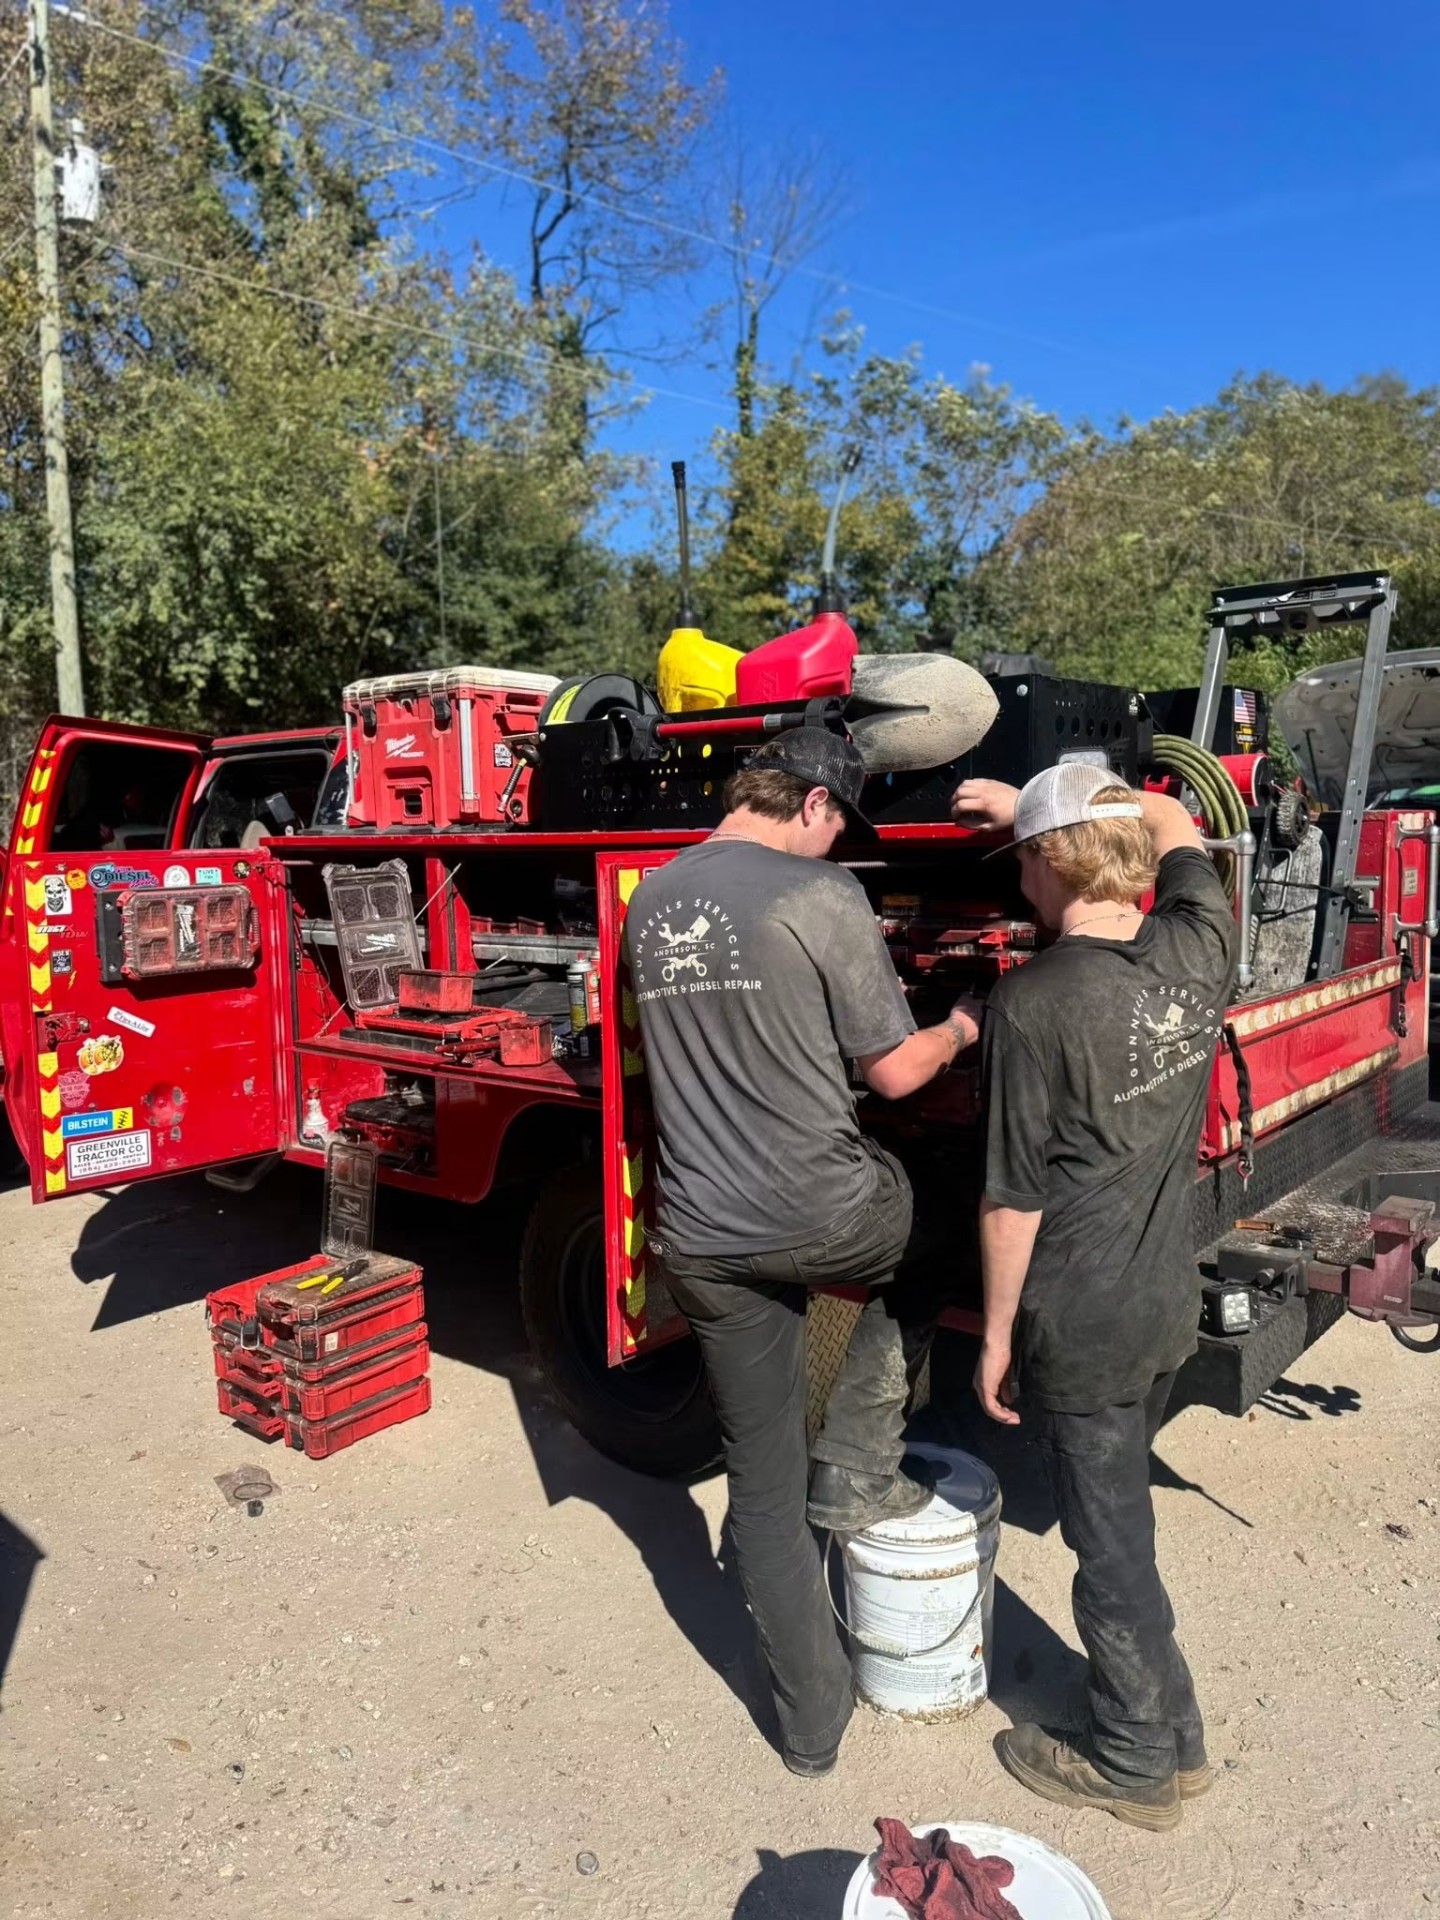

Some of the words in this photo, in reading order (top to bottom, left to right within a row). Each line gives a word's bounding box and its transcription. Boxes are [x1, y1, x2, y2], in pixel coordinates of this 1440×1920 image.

[694, 898, 740, 971] SERVICES
[654, 944, 701, 957] ANDERSON,
[705, 942, 716, 950] SC
[680, 984, 687, 994] &
[690, 980, 722, 993] DIESEL
[724, 980, 762, 990] REPAIR
[1159, 986, 1215, 1034] SERVICS
[1113, 1071, 1168, 1104] AUTOMOTIVE
[1169, 1067, 1175, 1077] &
[67, 1116, 109, 1131] BILSTEIN
[76, 1147, 126, 1163] TRACTOR
[128, 1144, 143, 1154] CO
[77, 1135, 141, 1154] GREENVILLE
